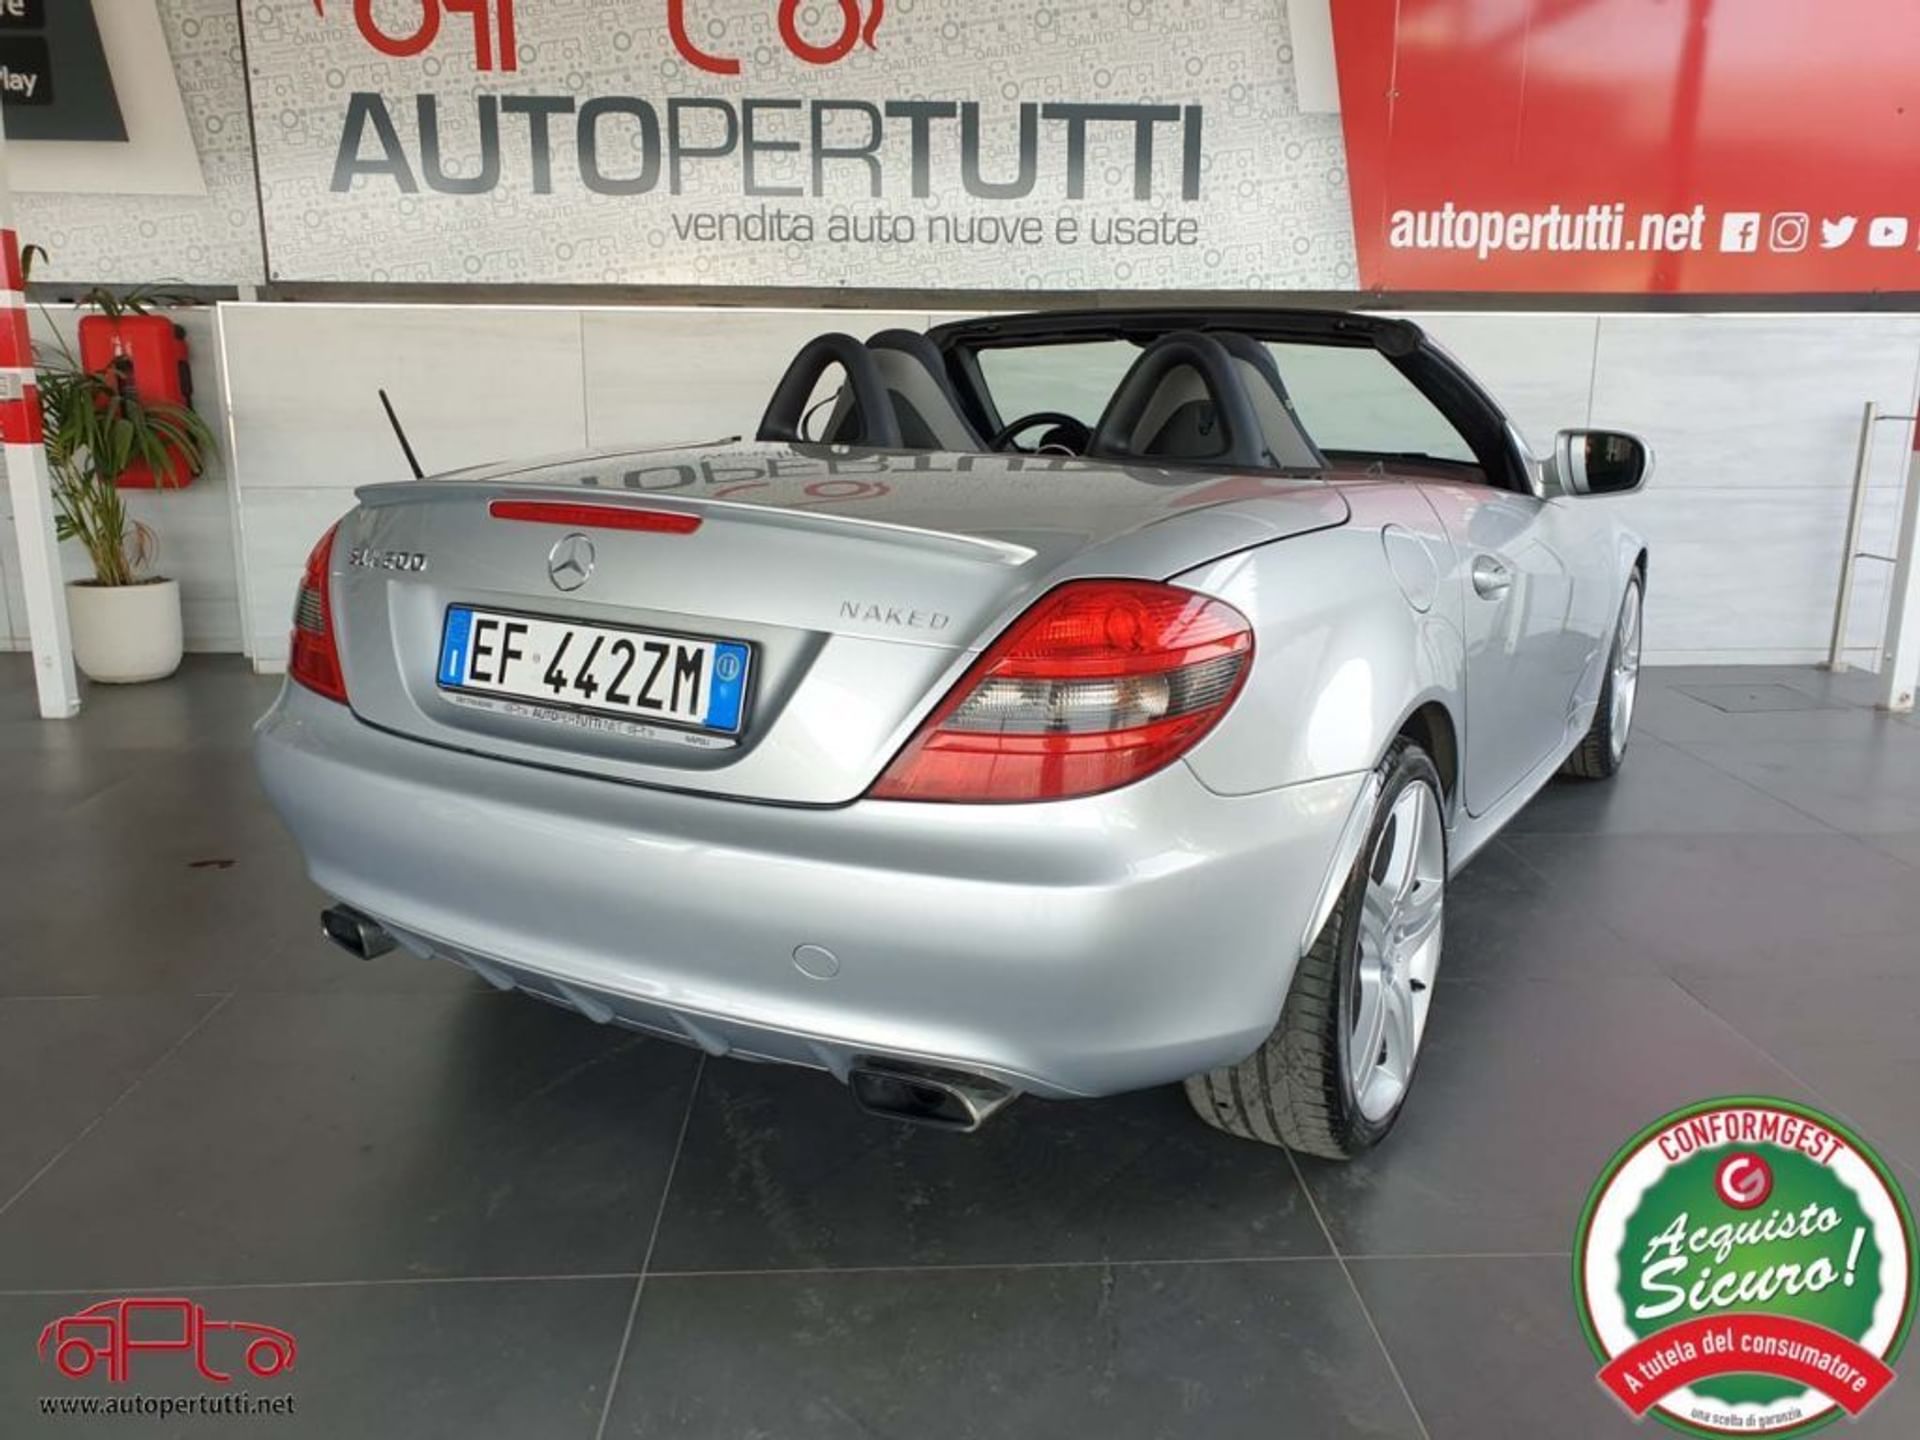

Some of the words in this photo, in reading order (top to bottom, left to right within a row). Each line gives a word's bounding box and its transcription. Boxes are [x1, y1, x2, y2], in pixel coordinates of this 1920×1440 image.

[329, 92, 1203, 201] AUTOPERTUTTI
[672, 204, 814, 242] vendita
[827, 210, 915, 244] auto
[928, 215, 1043, 245] nuove
[1055, 217, 1078, 246] e
[1091, 211, 1198, 246] usate
[1390, 202, 1705, 259] autopertutti.net
[840, 599, 950, 629] NAKED
[469, 618, 529, 685] EF
[543, 631, 705, 716] 442ZM
